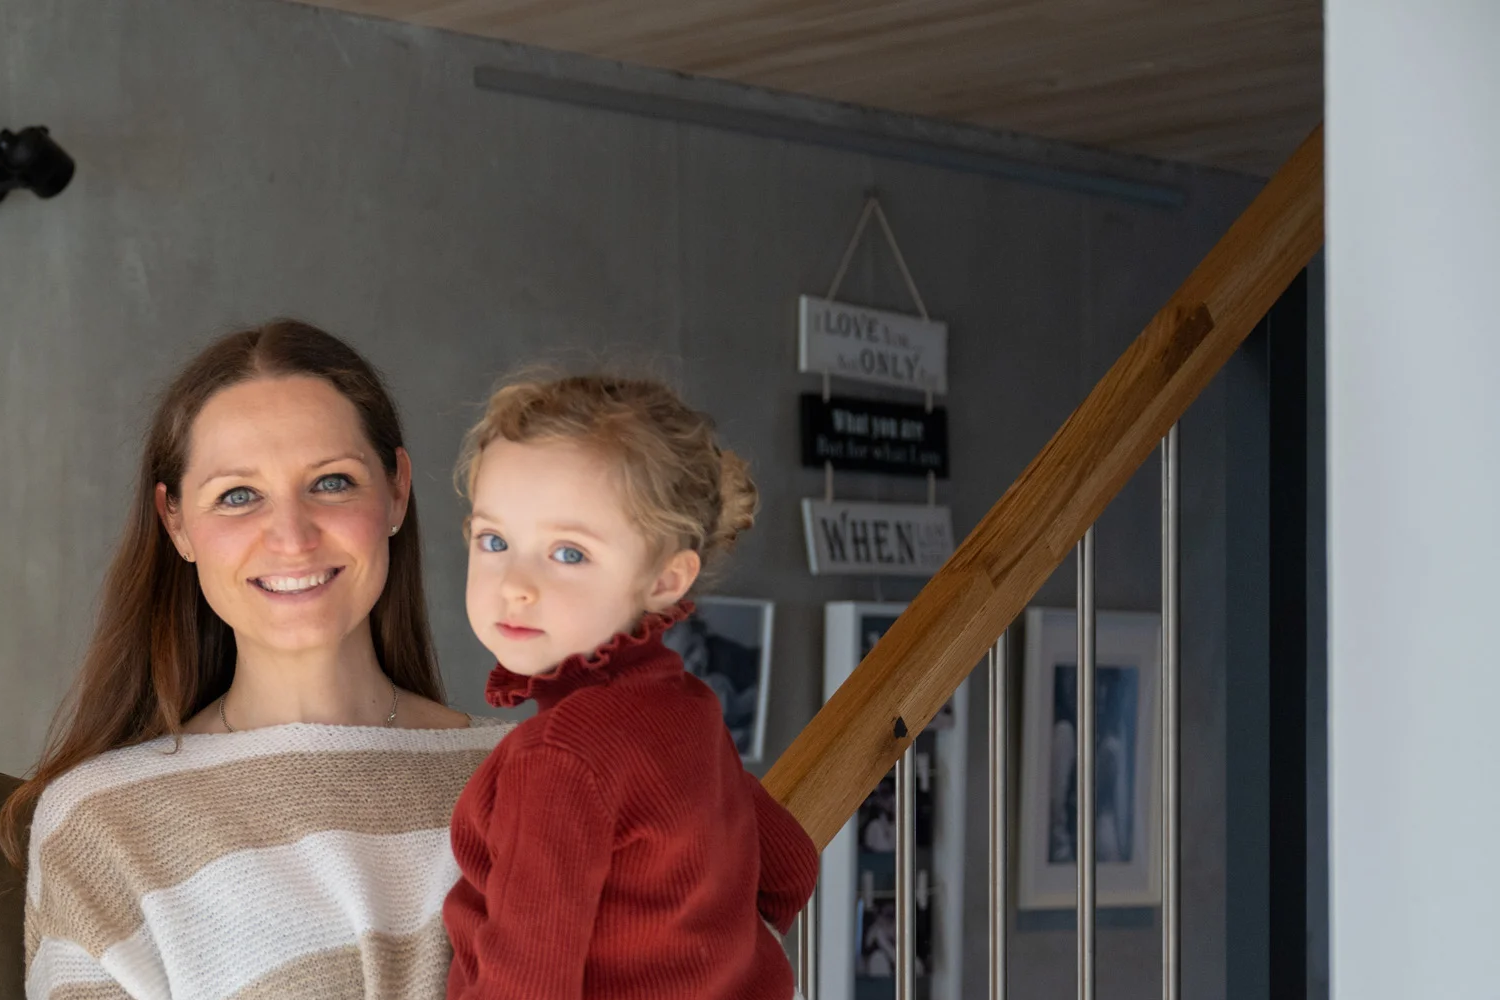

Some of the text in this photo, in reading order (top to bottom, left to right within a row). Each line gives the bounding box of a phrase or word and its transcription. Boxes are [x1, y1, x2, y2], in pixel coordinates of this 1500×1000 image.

[824, 309, 880, 343] LOVE
[859, 348, 922, 381] ONLY
[820, 511, 915, 564] WHEN
